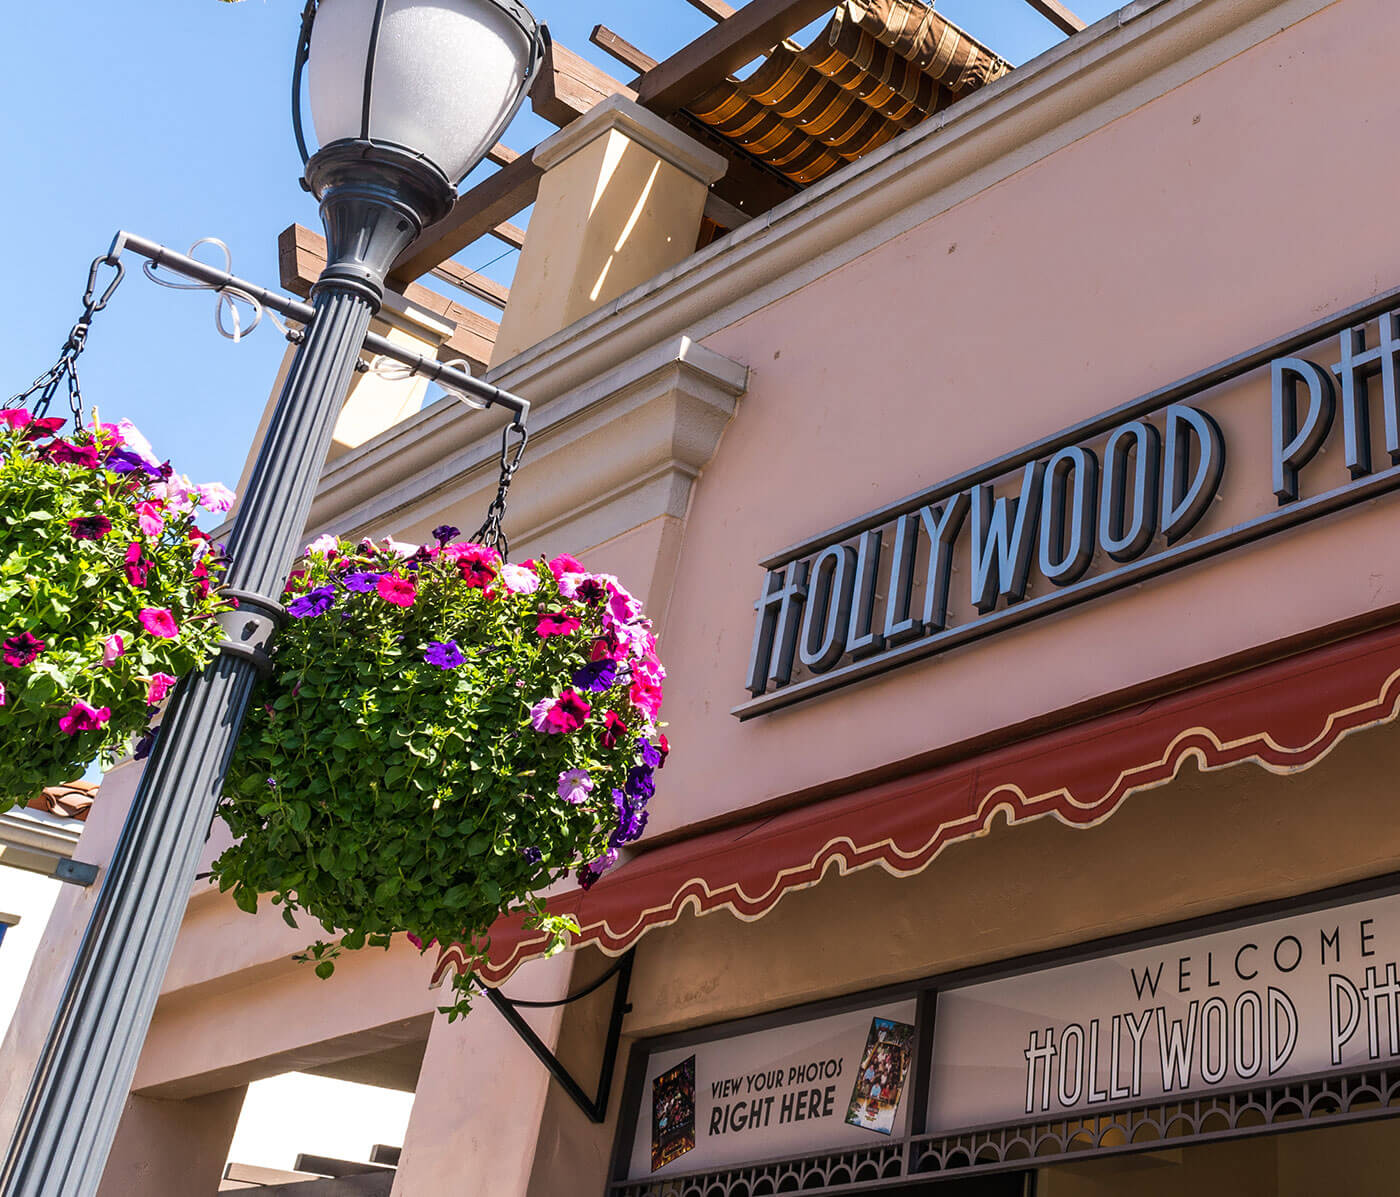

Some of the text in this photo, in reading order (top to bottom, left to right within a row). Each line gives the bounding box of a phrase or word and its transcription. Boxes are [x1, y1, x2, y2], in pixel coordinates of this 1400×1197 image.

[746, 404, 1225, 698] HOLLYWOOD
[1131, 918, 1375, 1000] WELCOME
[711, 1057, 844, 1099] VIEW YOUR PHOTOS
[1023, 985, 1299, 1114] HOLLYWOOD
[708, 1095, 775, 1137] RIGHT
[779, 1085, 837, 1125] HERE
